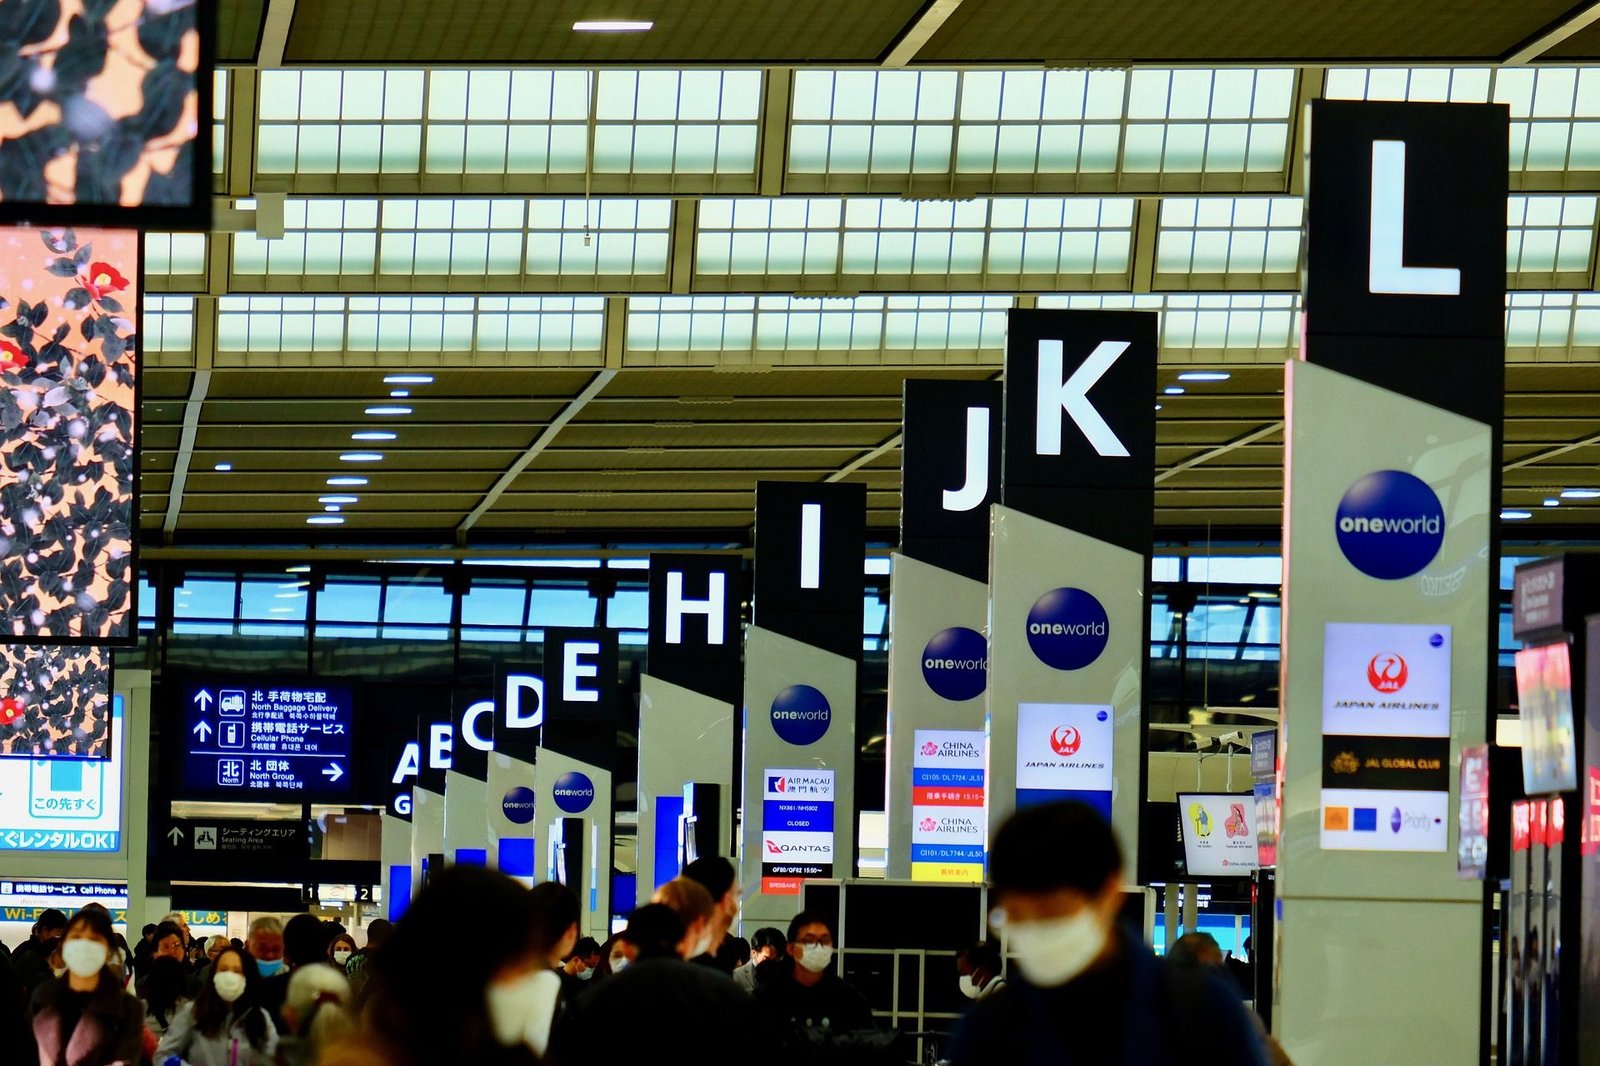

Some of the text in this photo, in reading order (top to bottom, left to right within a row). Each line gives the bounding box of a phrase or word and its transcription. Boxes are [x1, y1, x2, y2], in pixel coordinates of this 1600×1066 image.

[1369, 140, 1460, 296] L
[1036, 340, 1132, 457] K
[943, 407, 990, 511] J
[1339, 514, 1441, 535] oneworld
[801, 504, 821, 589] I
[666, 572, 725, 645] H
[1029, 621, 1106, 636] oneworld
[563, 643, 600, 702] E
[252, 690, 327, 703] 北 手荷物宅配
[506, 676, 544, 729] D
[251, 703, 338, 714] North Baggage Delivery
[1334, 701, 1440, 711] JAPAN AIRLINES
[772, 708, 828, 721] oneworld
[251, 721, 345, 735] 携帯電話サービス
[461, 701, 495, 751] C
[250, 734, 304, 743] Cellular Phone
[430, 725, 453, 769] B
[942, 741, 974, 750] CHINA
[937, 750, 980, 758] AIRLINES
[222, 761, 240, 778] 北
[250, 760, 290, 772] 北 団体
[392, 743, 419, 784] A
[1381, 758, 1417, 769] GLOBAL
[1418, 759, 1441, 770] CLUB
[249, 772, 295, 782] North Group
[788, 777, 830, 786] AIR MACAU
[554, 788, 593, 797] oneworld
[34, 798, 97, 811] この先すぐ
[394, 796, 411, 814] G
[941, 817, 973, 826] CHINA
[221, 828, 297, 838] シーティングエリア
[935, 826, 978, 834] AIRLINES
[0, 830, 116, 849] ぐレンタルOK!
[780, 844, 831, 853] QANTAS
[80, 886, 94, 894] Cell
[95, 886, 117, 895] Phone
[308, 887, 313, 899] 1
[360, 889, 369, 900] 2
